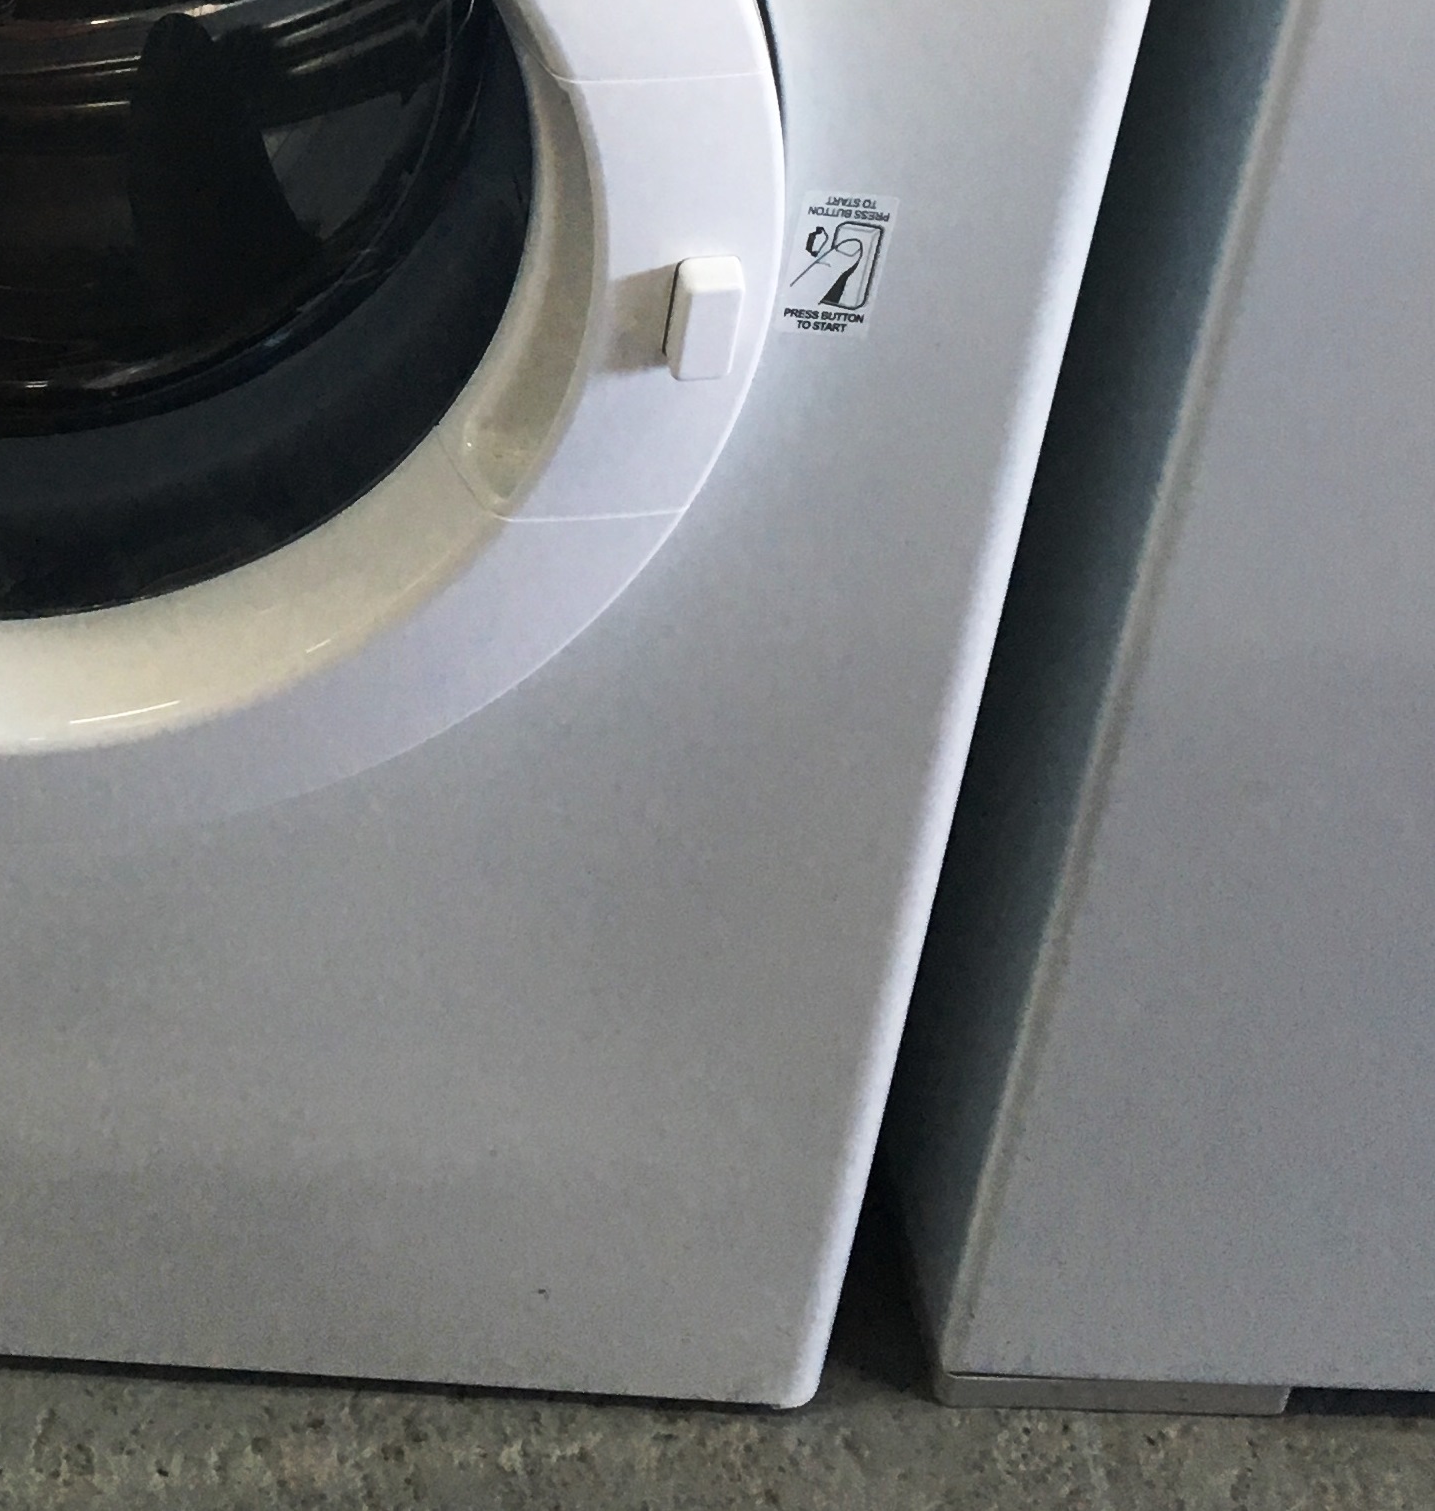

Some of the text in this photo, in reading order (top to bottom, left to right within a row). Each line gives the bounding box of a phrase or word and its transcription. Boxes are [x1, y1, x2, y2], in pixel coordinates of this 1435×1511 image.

[826, 196, 877, 209] TO START
[808, 206, 891, 222] PRESS BUTTON
[783, 307, 865, 324] PRESS BUTTON
[797, 320, 848, 333] TO START
